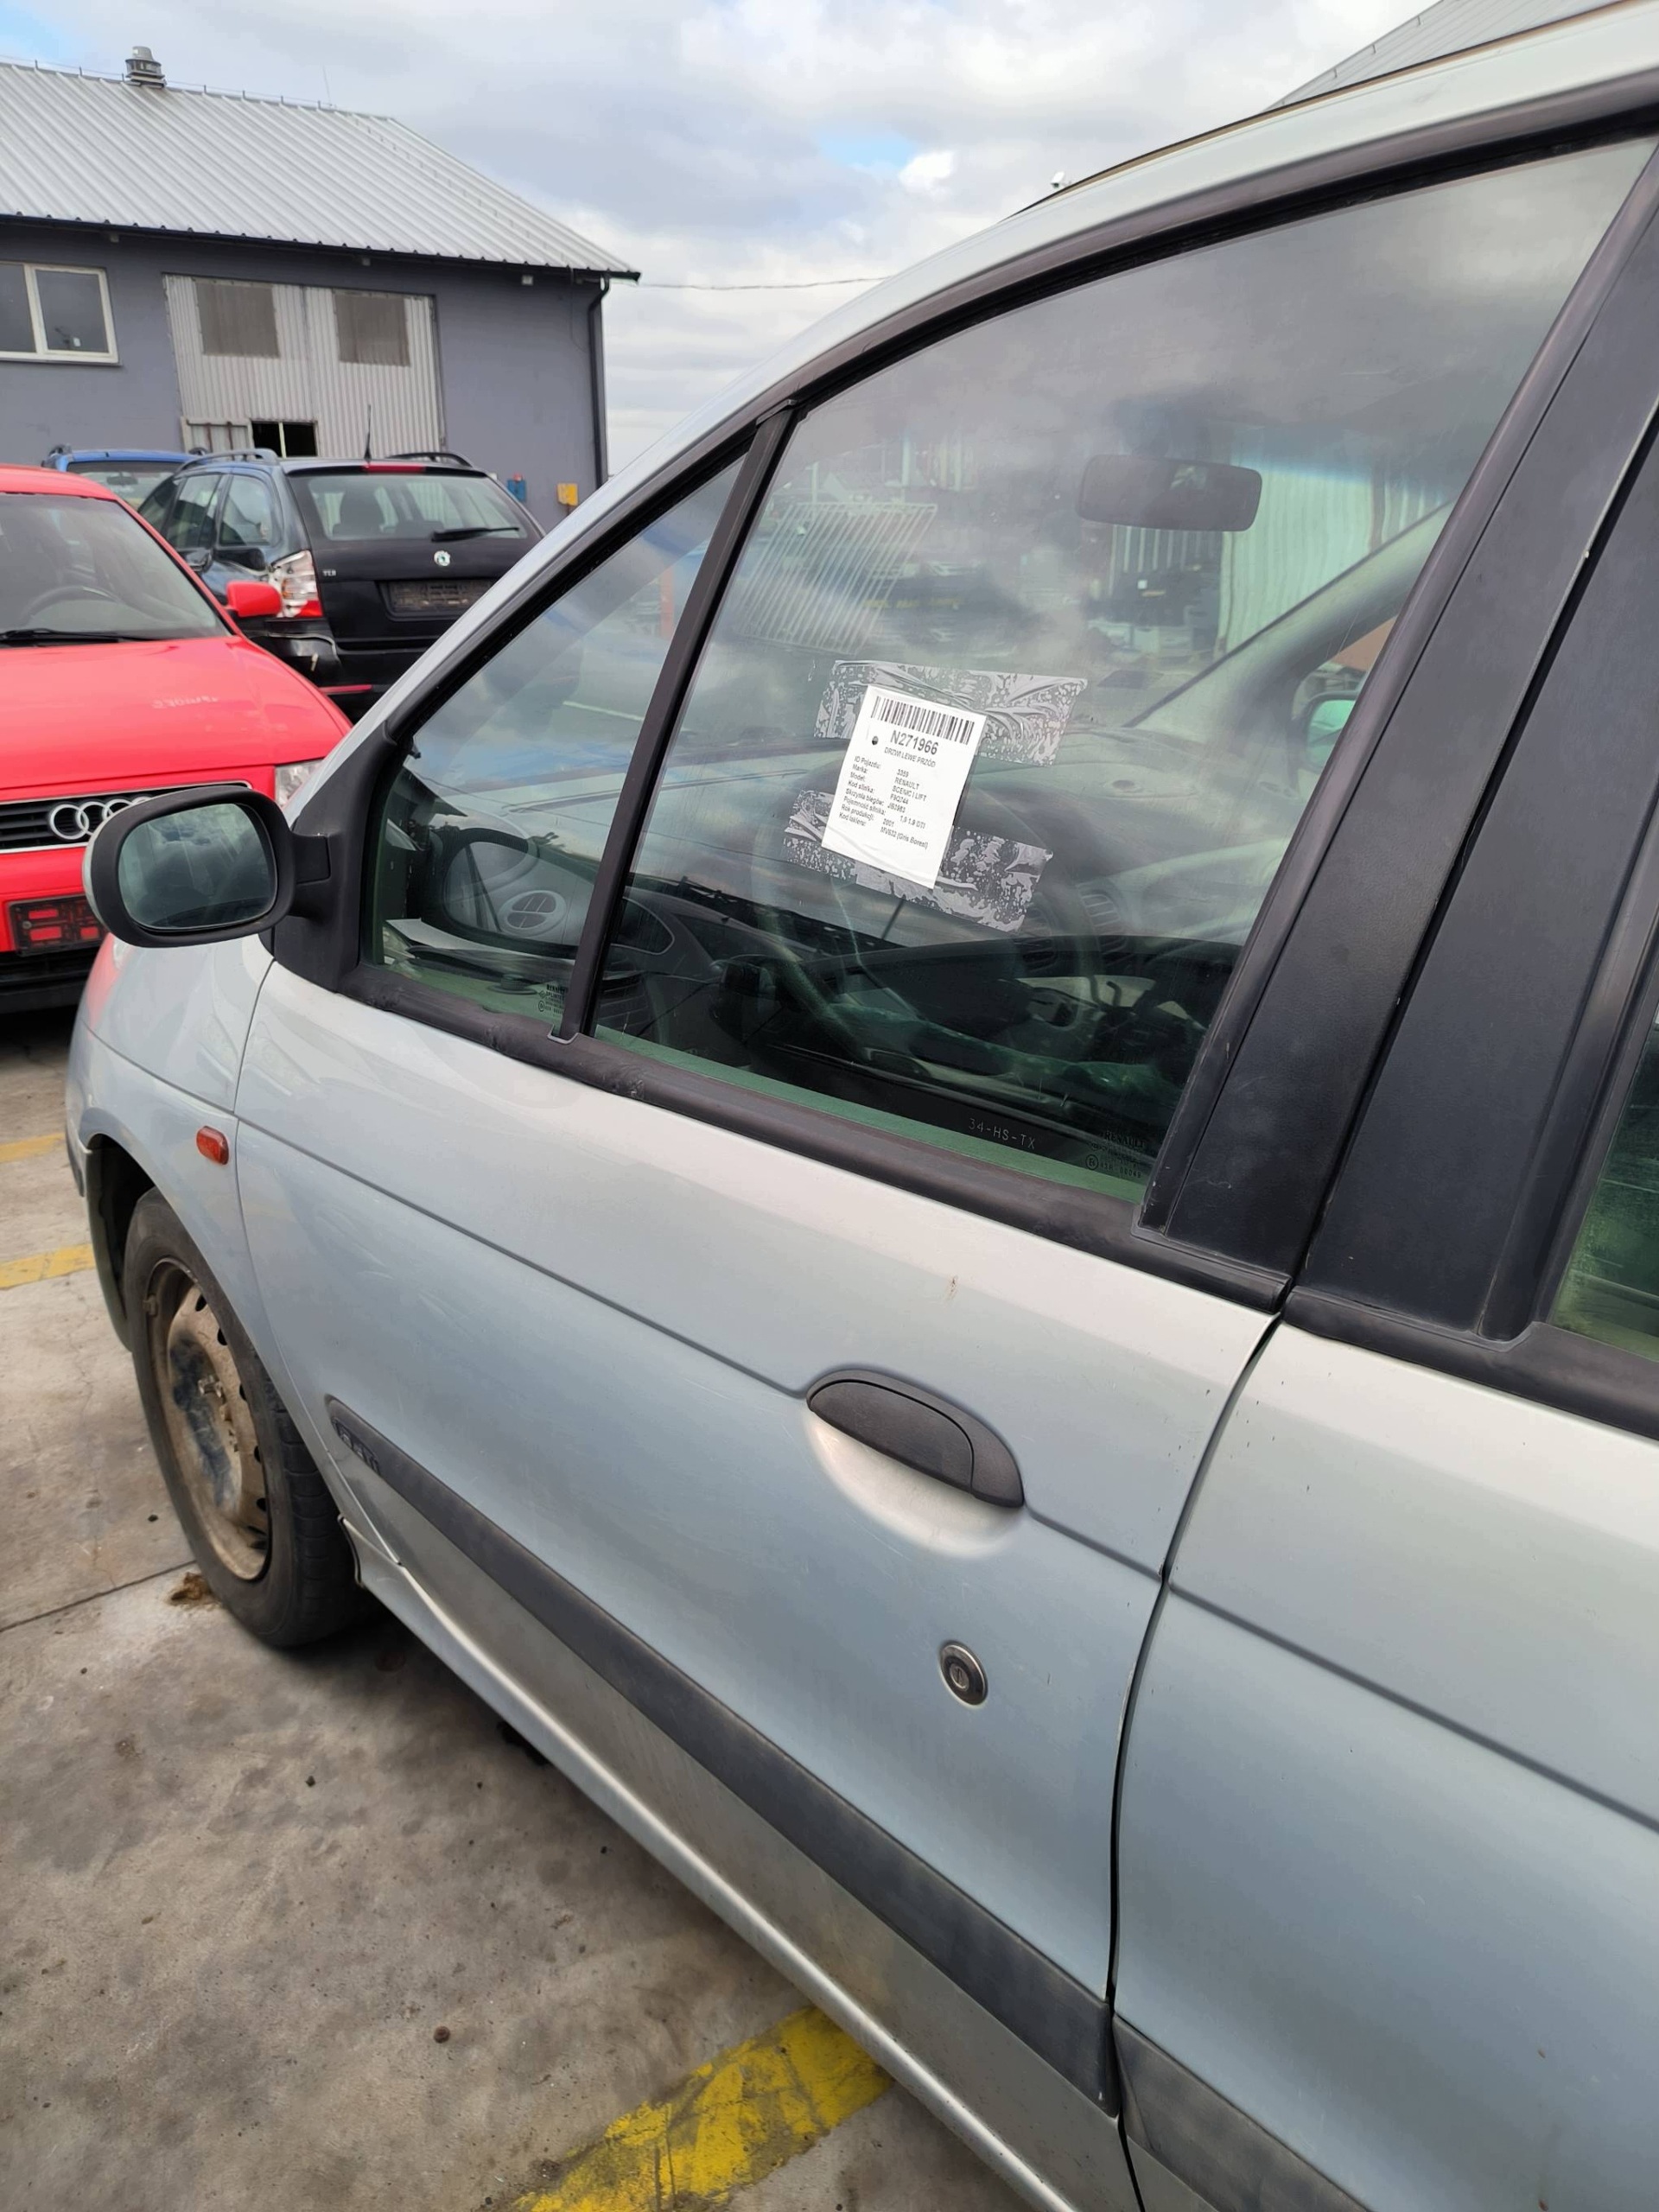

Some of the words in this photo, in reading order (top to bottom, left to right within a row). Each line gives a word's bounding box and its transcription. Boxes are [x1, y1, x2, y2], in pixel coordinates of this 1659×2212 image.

[891, 730, 938, 754] N271966
[885, 747, 900, 756] DRZWI
[901, 752, 916, 761] LEWE
[893, 785, 912, 796] SCENIC
[894, 777, 918, 790] RENAULT
[968, 1118, 1036, 1150] 34-HS-TX
